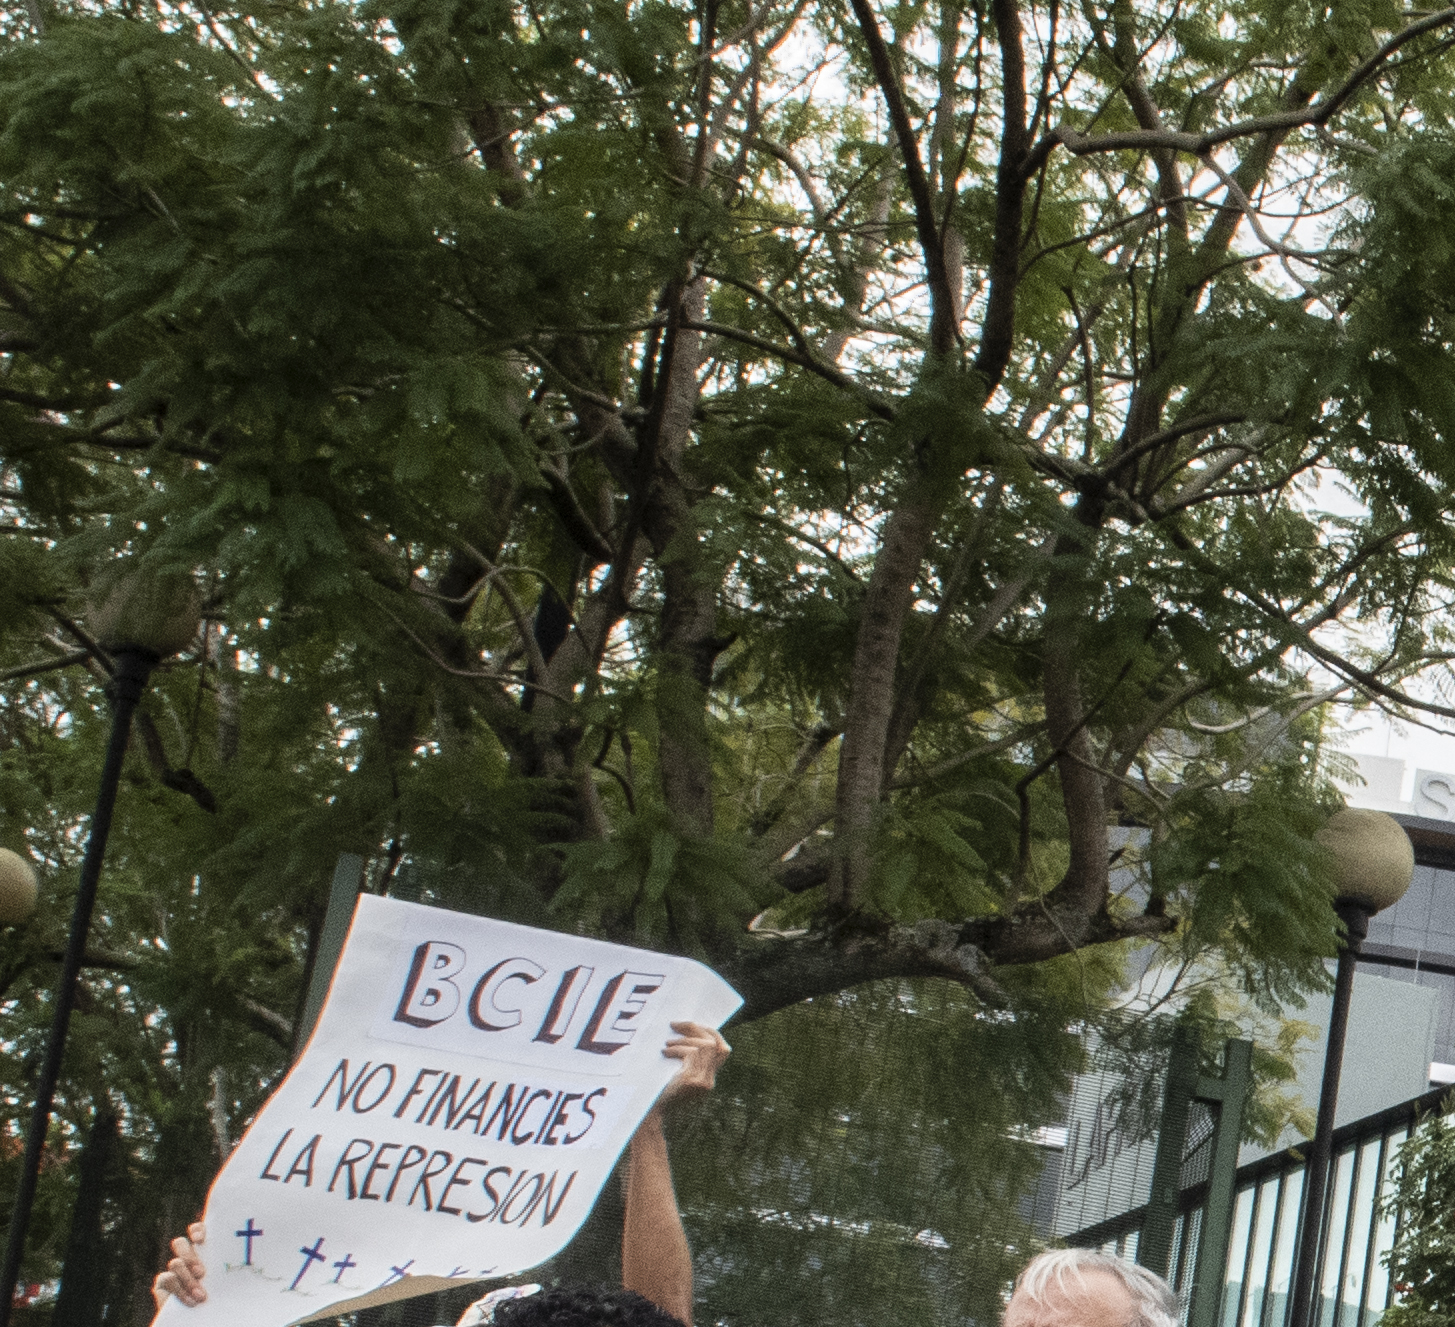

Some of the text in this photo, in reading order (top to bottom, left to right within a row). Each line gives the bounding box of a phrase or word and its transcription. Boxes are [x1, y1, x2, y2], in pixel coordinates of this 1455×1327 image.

[392, 940, 666, 1056] BCIE
[312, 1058, 607, 1147] NO FINANCIES
[260, 1128, 578, 1229] LA REPRESION
